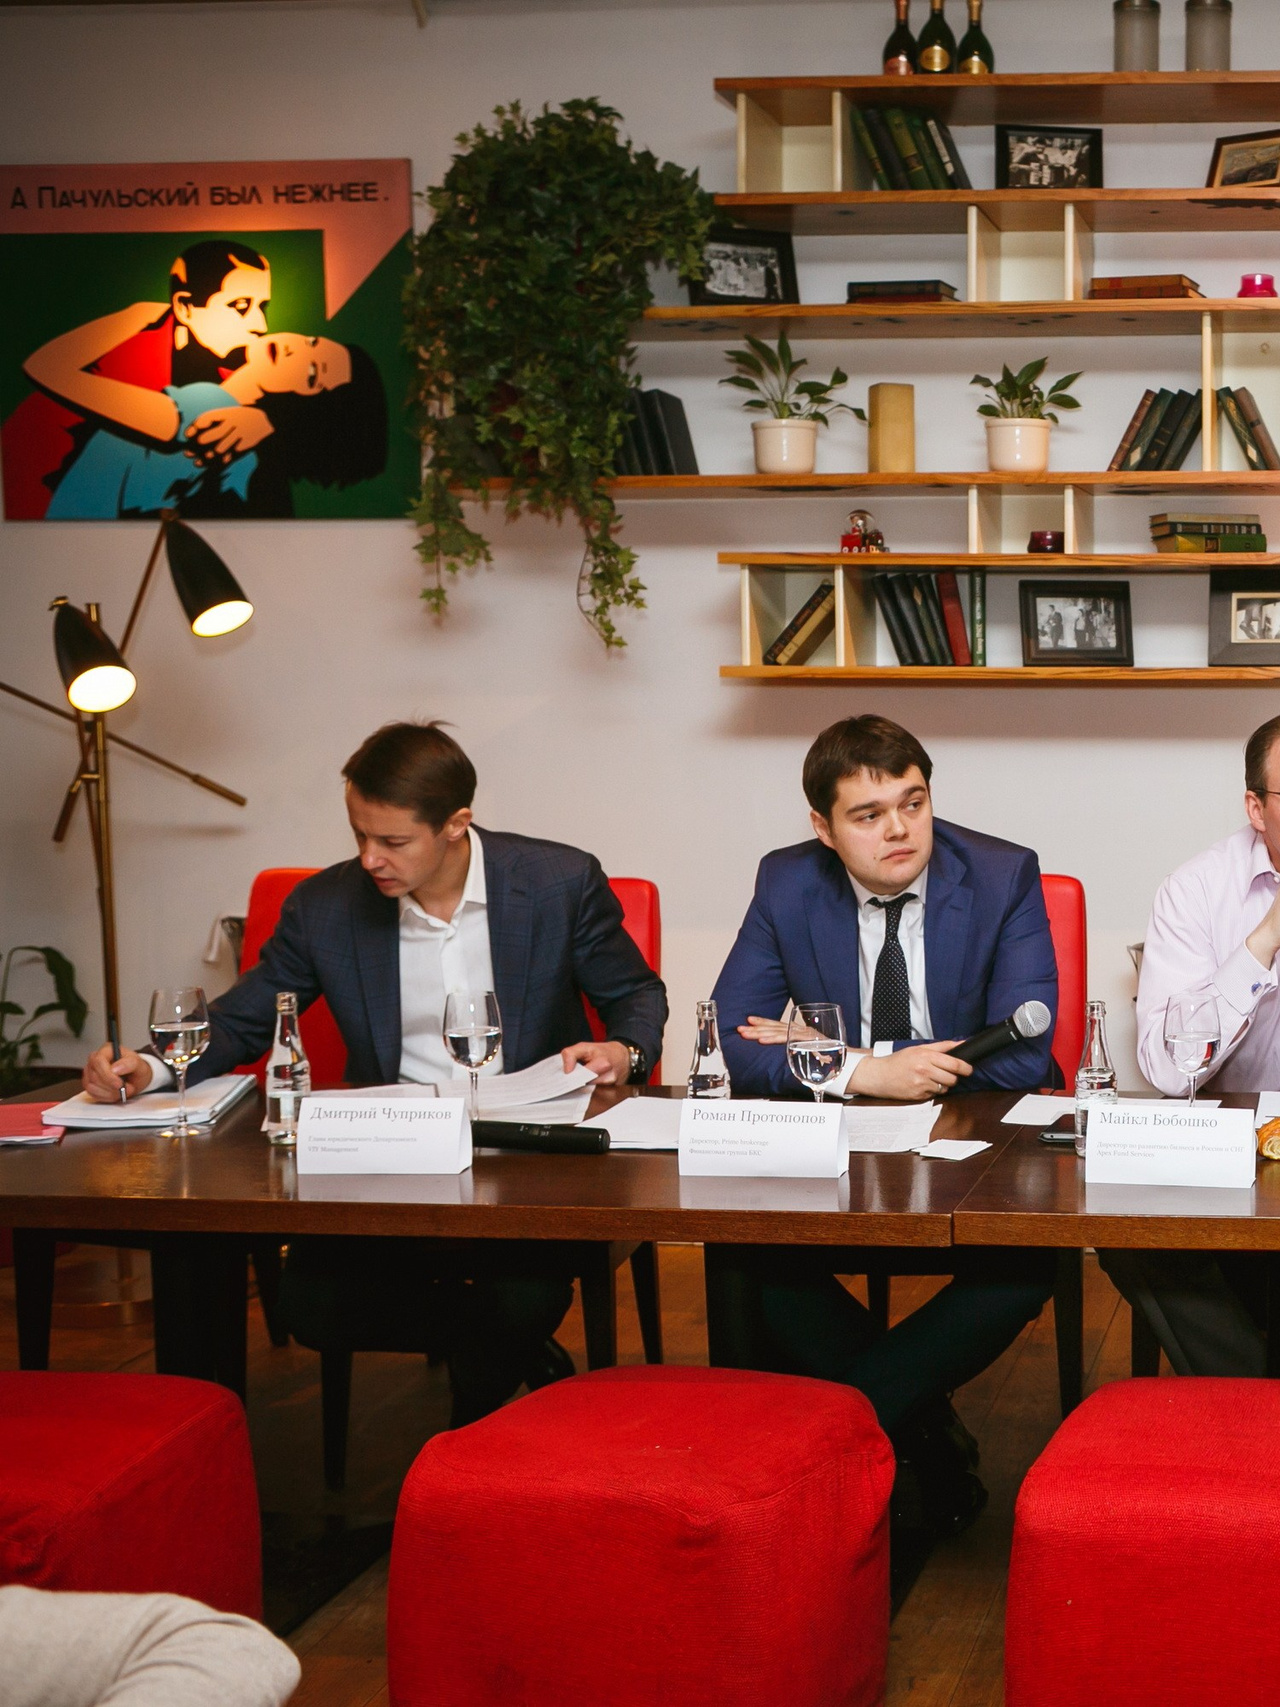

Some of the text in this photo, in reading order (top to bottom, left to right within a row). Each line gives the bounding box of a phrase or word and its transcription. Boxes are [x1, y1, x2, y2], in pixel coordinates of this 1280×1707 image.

[10, 186, 27, 209] А
[209, 185, 262, 206] БЫЛ
[310, 1107, 452, 1122] Дмитрий Чуприков
[692, 1109, 826, 1125] Роман Протопопов
[1100, 1112, 1218, 1128] Майкл Бобошко
[1097, 1142, 1128, 1150] Директор
